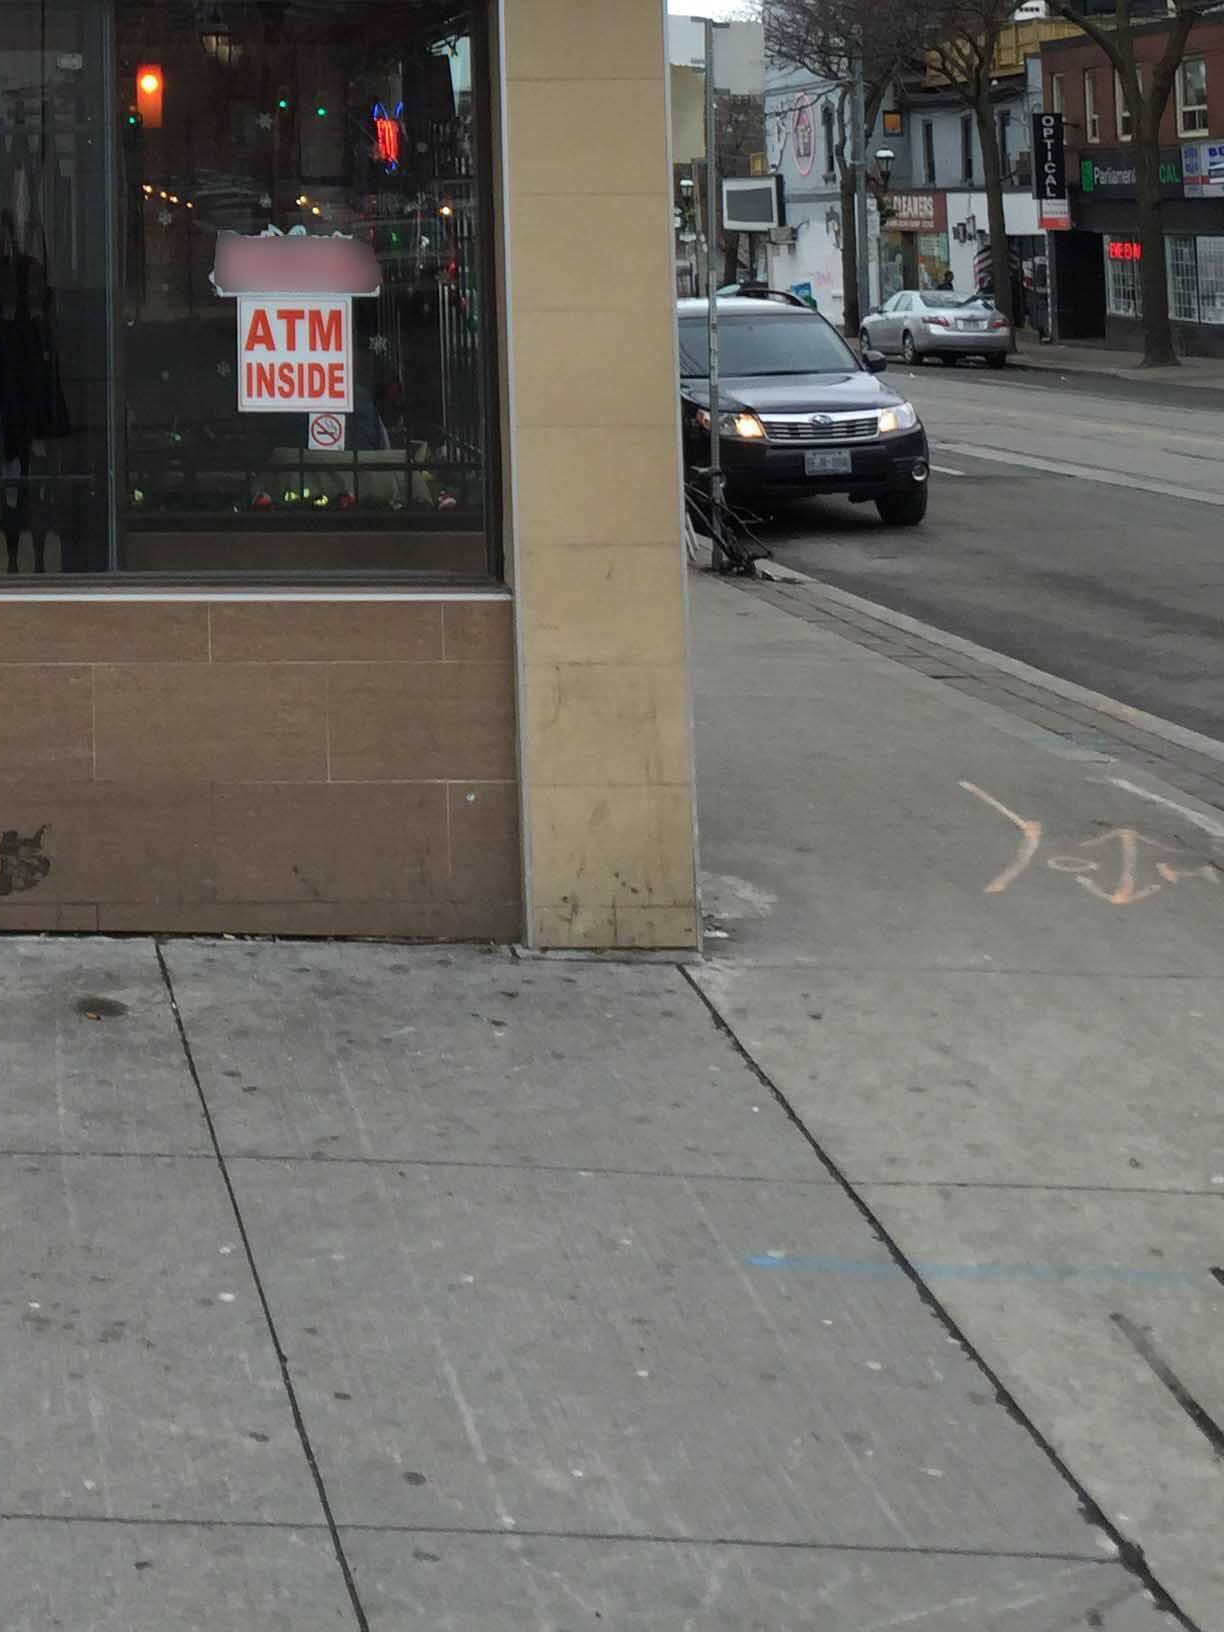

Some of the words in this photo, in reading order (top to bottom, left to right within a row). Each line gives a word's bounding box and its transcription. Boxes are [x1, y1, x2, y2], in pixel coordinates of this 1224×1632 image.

[1041, 115, 1057, 198] OPTICAL
[893, 195, 935, 219] CLEANERS
[244, 308, 343, 352] ATM
[246, 362, 346, 399] INSIDE
